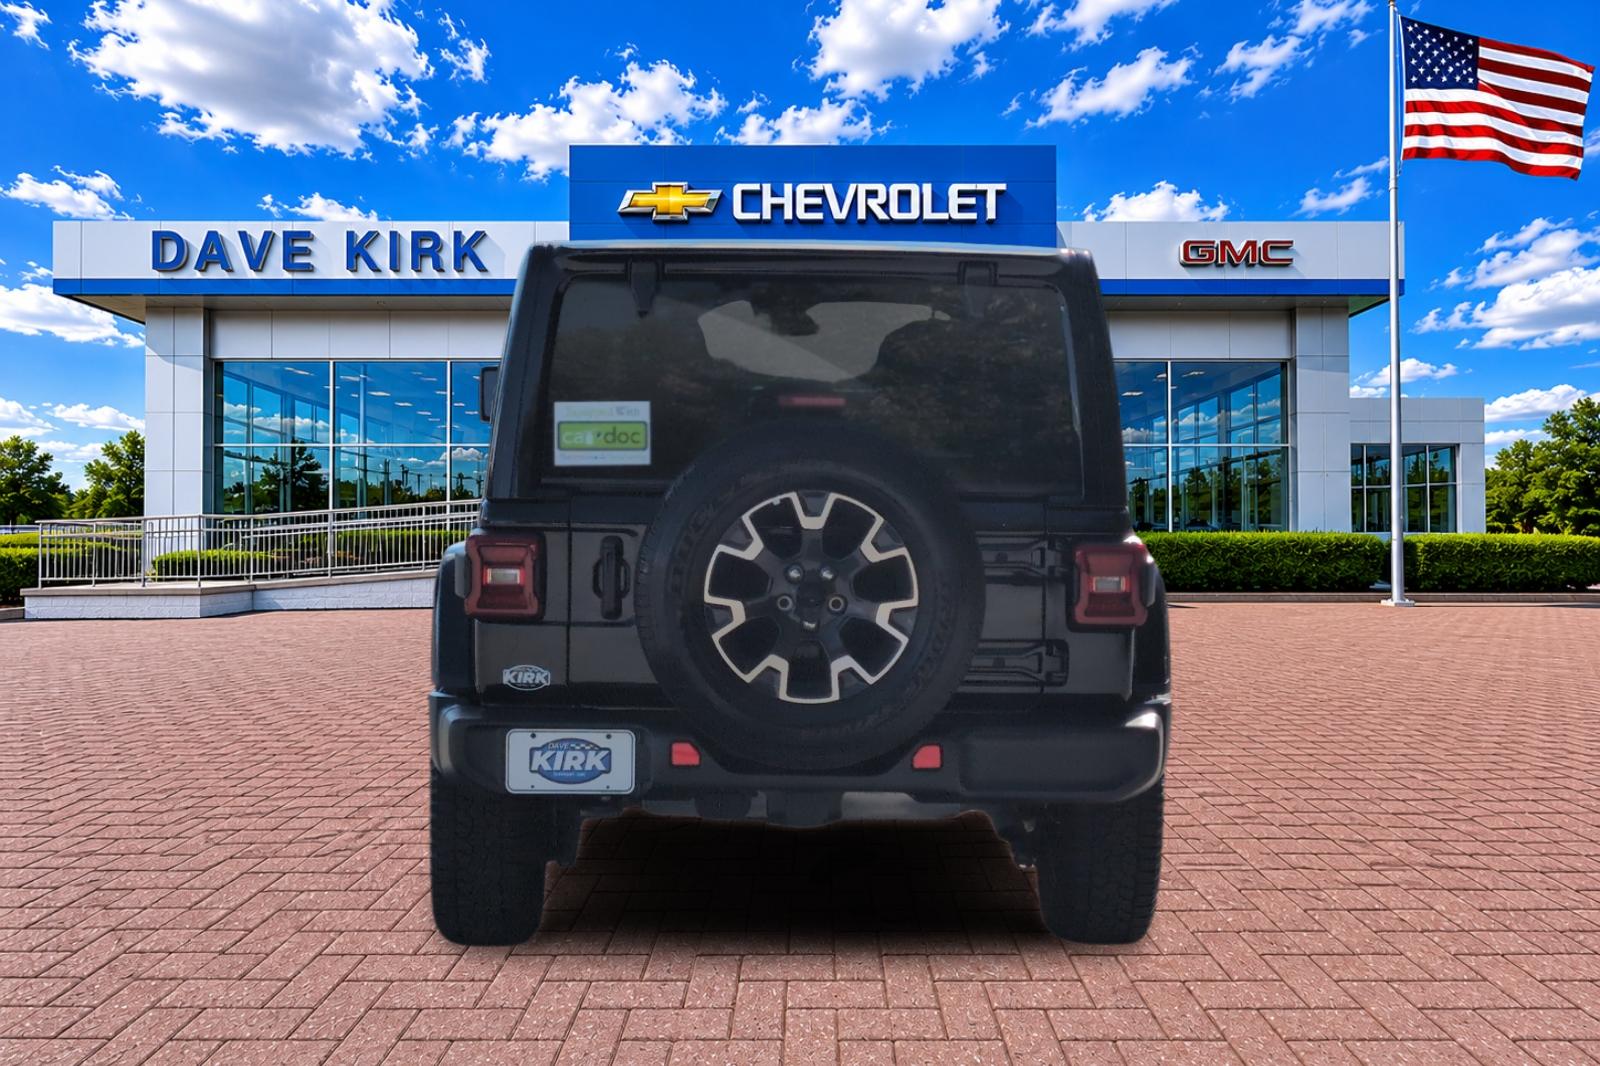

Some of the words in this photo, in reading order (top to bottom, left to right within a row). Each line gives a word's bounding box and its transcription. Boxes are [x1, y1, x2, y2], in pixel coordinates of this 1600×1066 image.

[732, 183, 1007, 221] CHEVROLET
[151, 230, 315, 273] DAVE
[346, 230, 490, 273] KIRK
[1180, 239, 1295, 267] GMC
[503, 671, 549, 684] KIRK
[531, 750, 609, 771] KIRK
